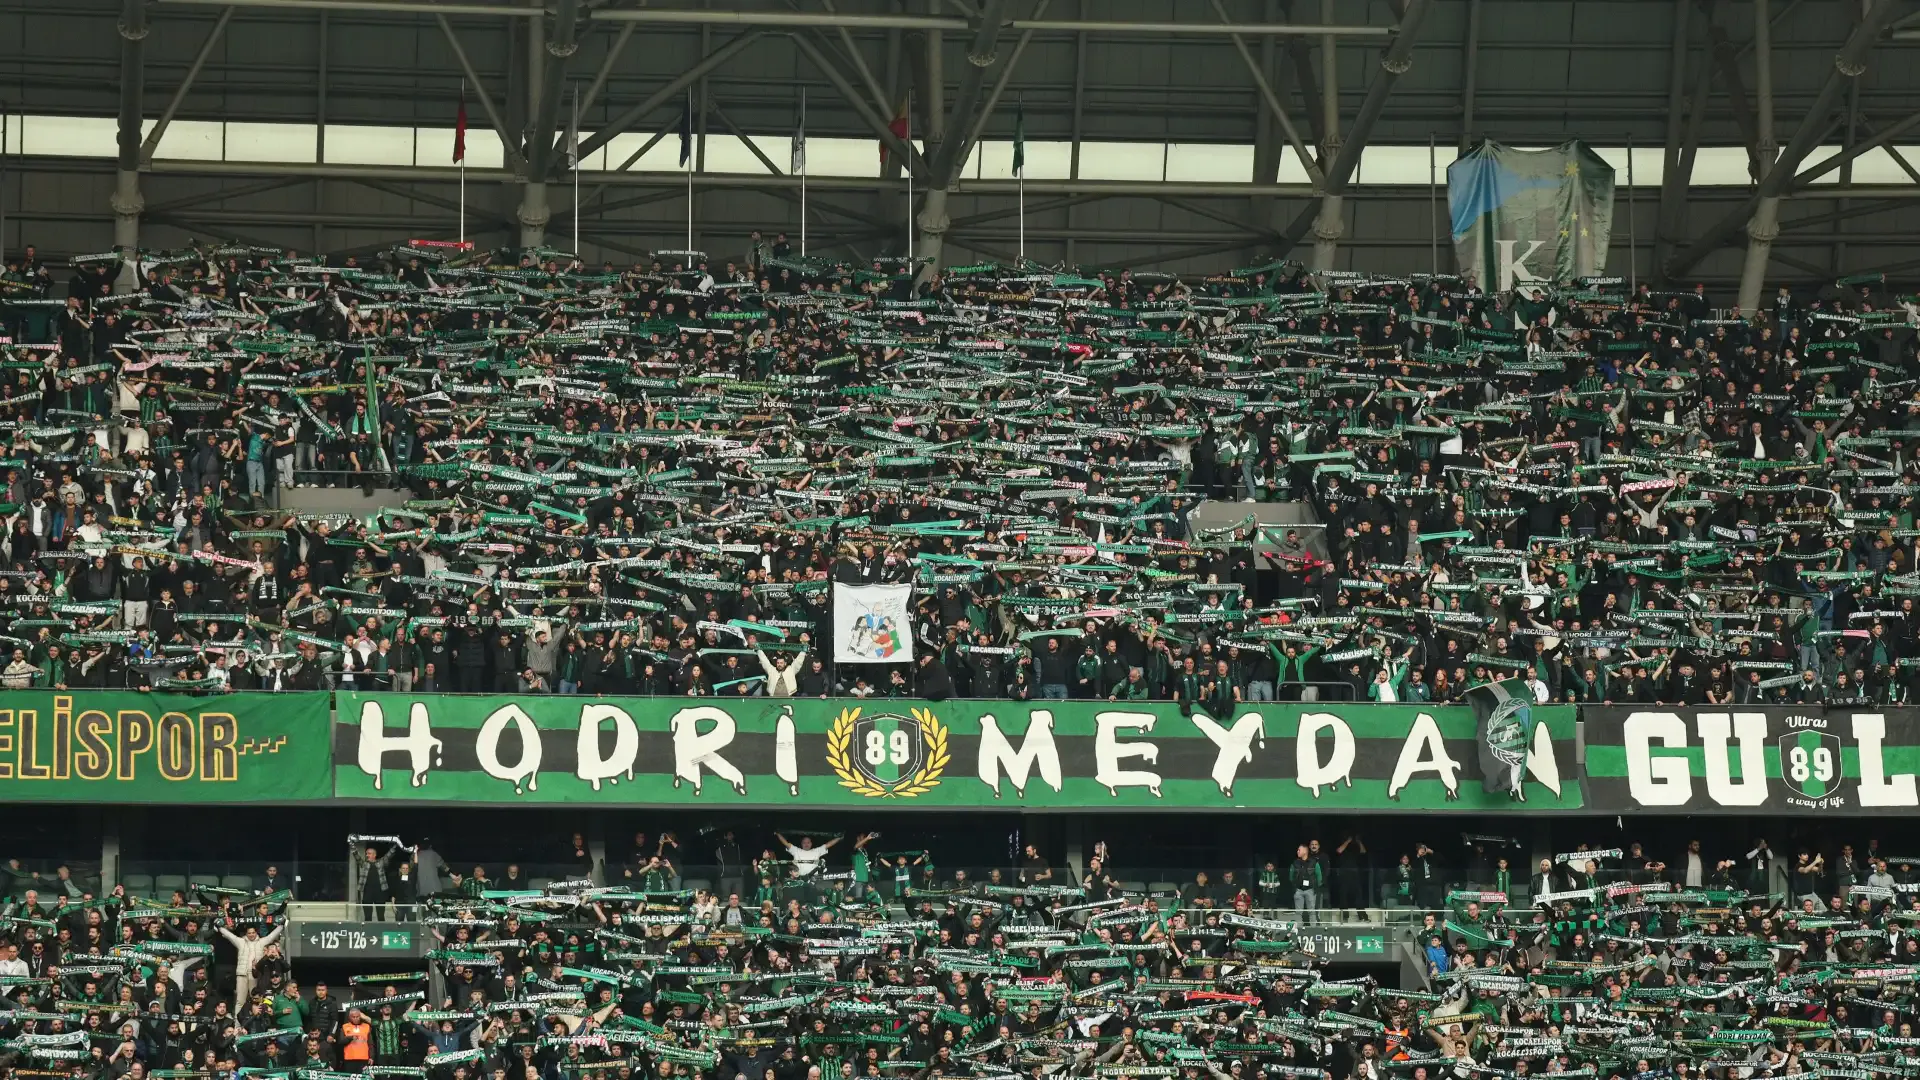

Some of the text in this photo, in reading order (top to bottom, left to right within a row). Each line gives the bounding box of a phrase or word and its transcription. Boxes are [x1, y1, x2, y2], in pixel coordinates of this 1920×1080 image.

[1785, 715, 1827, 728] Ultras
[866, 730, 910, 765] 89
[1790, 747, 1833, 781] 89
[1796, 799, 1816, 809] way
[1819, 800, 1828, 809] of
[1830, 797, 1845, 807] life
[321, 931, 367, 949] 125 126
